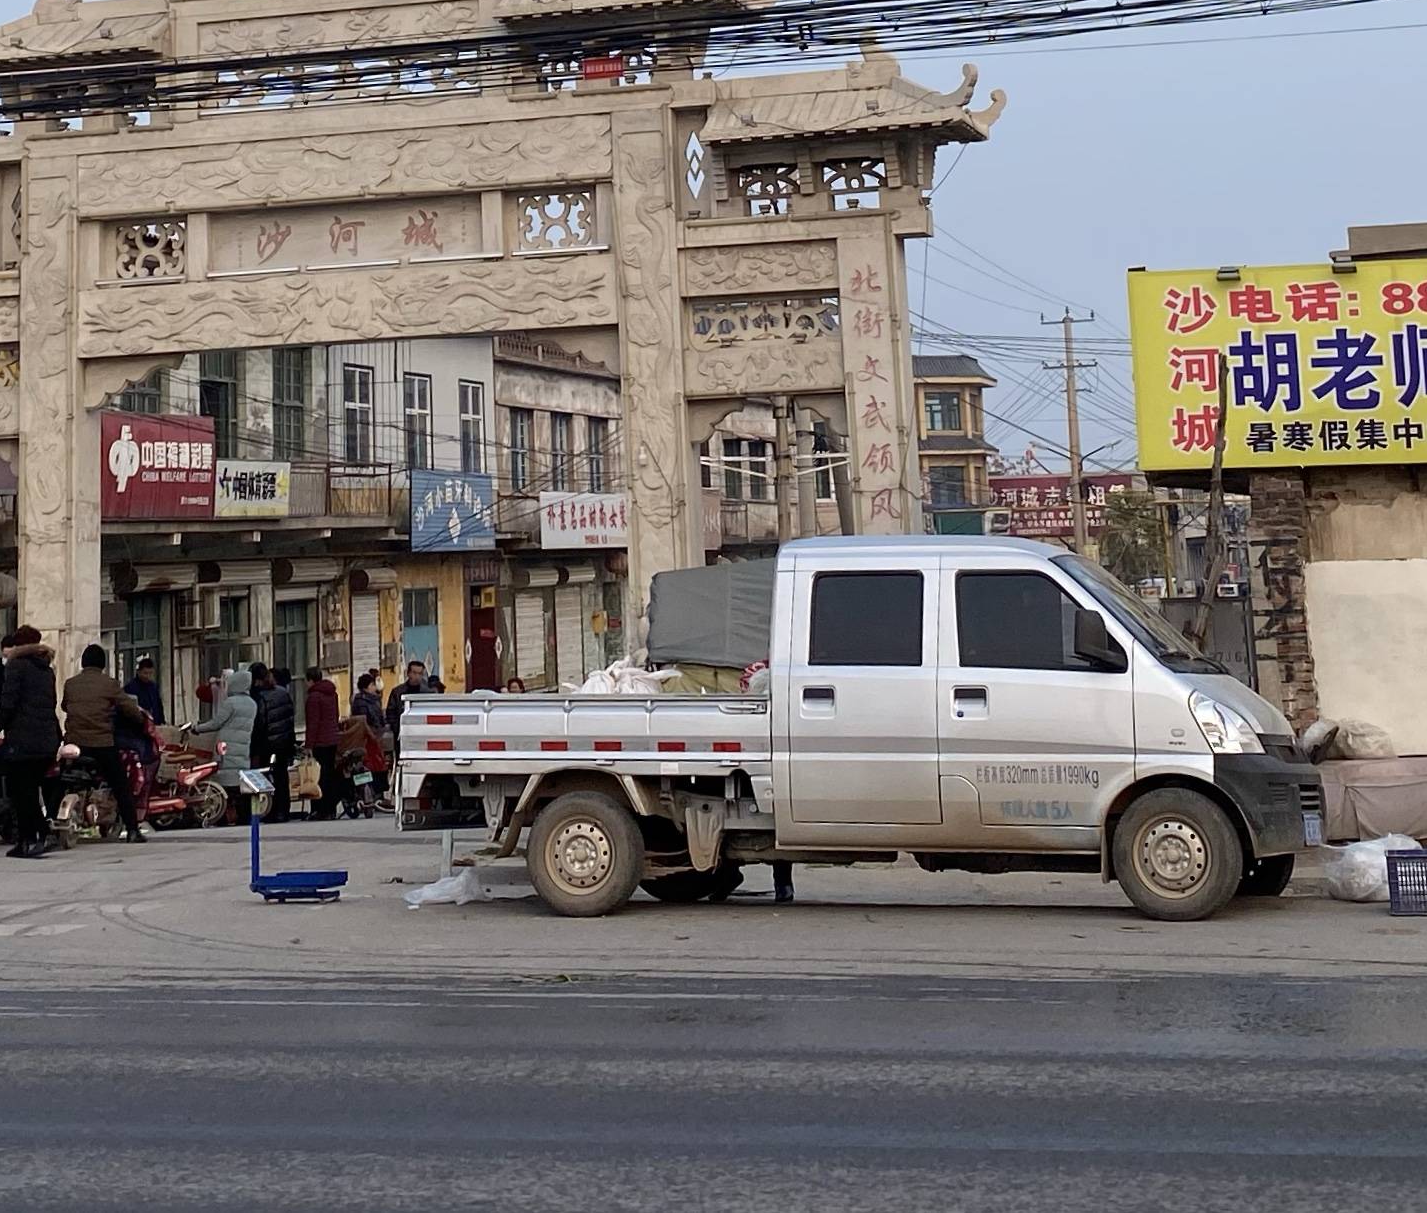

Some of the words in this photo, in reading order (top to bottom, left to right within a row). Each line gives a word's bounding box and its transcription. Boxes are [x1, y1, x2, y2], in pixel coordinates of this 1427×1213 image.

[257, 209, 444, 266] 沙河城
[1163, 285, 1225, 454] 沙河城
[141, 440, 213, 470] 中国福利彩票
[141, 471, 159, 482] CHINA
[161, 471, 187, 483] WELFARE
